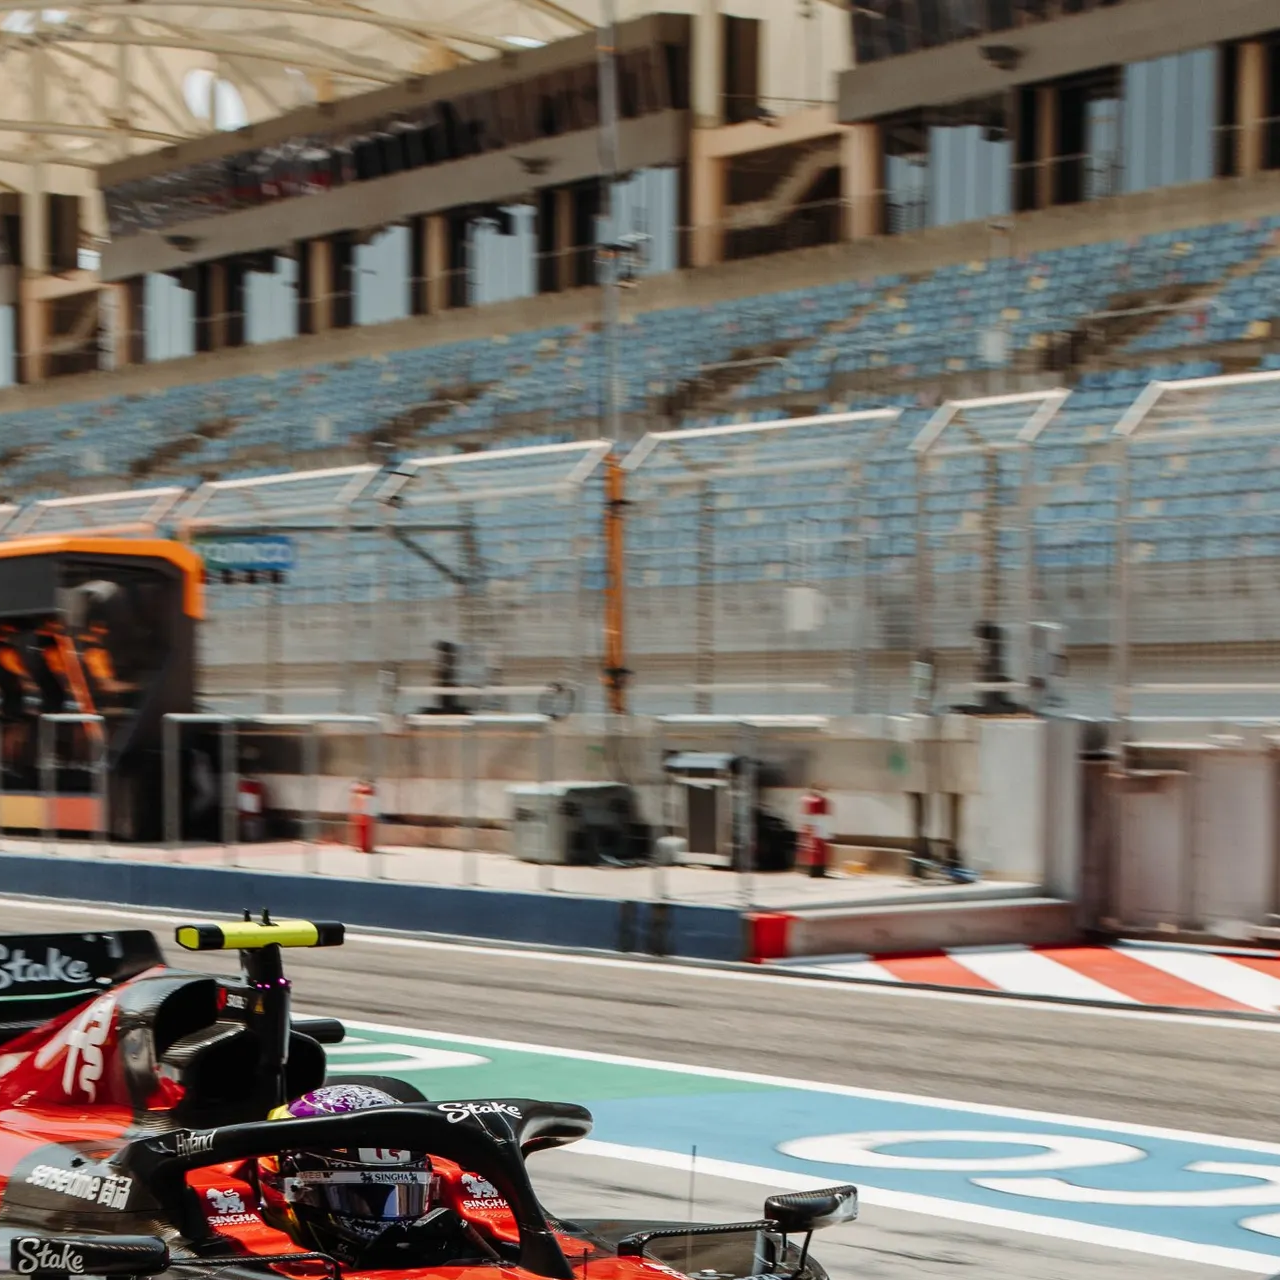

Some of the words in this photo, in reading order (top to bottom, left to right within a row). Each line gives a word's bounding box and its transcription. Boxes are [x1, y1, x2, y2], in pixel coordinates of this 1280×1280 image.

[437, 1101, 522, 1123] Stake
[176, 1130, 216, 1160] Hyland
[374, 1172, 409, 1181] SINGHA
[207, 1213, 259, 1225] SINGHA
[18, 1237, 85, 1274] Stake
